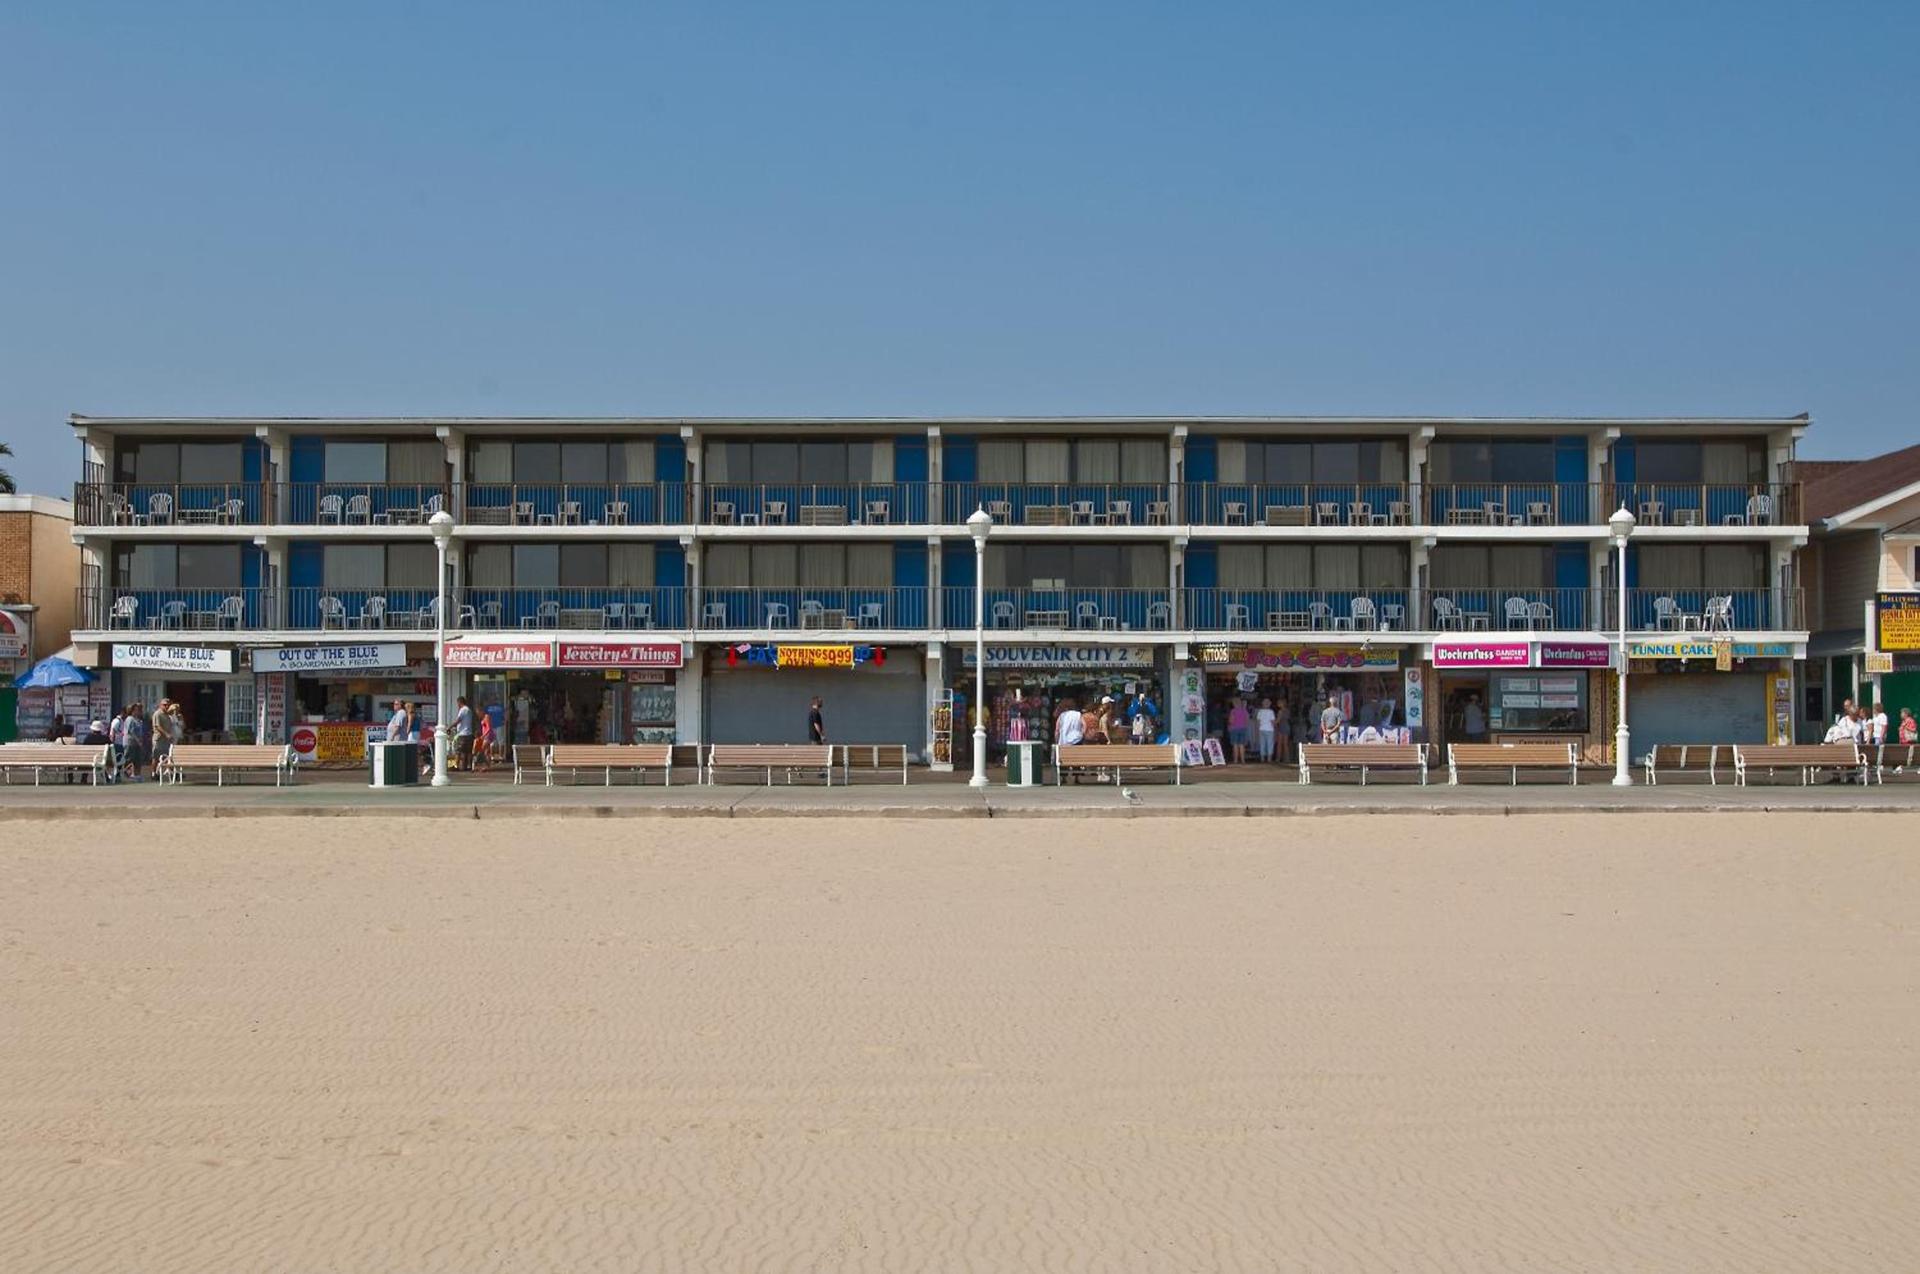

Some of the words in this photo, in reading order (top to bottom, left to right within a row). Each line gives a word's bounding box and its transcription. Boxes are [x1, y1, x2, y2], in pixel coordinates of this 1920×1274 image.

[128, 646, 147, 658] OUT
[149, 646, 162, 658] OF
[167, 647, 186, 659] THE
[189, 648, 216, 661] BLUE
[278, 649, 301, 661] OUT
[303, 648, 319, 661] OF
[321, 647, 345, 660] THE
[348, 646, 379, 659] BLUE
[446, 647, 496, 664] Jewelry
[496, 650, 504, 660] &
[504, 647, 546, 664] Things
[563, 647, 620, 664] Jewelry
[620, 650, 629, 660] &
[629, 647, 677, 664] Things
[779, 648, 823, 658] NOTHING
[985, 647, 1071, 661] SOUVENIR
[1075, 647, 1112, 661] CITY
[1118, 648, 1128, 661] 2
[1438, 648, 1495, 660] Wockenfuss
[1543, 648, 1585, 660] Wockenfuss
[1633, 644, 1677, 656] FUNNEL
[1680, 643, 1714, 656] CAKE
[140, 659, 184, 668] BOARDWALK
[186, 661, 212, 669] FIESTA
[289, 659, 346, 669] BOARDWALK
[348, 658, 380, 667] FIESTA
[786, 658, 815, 667] OVER
